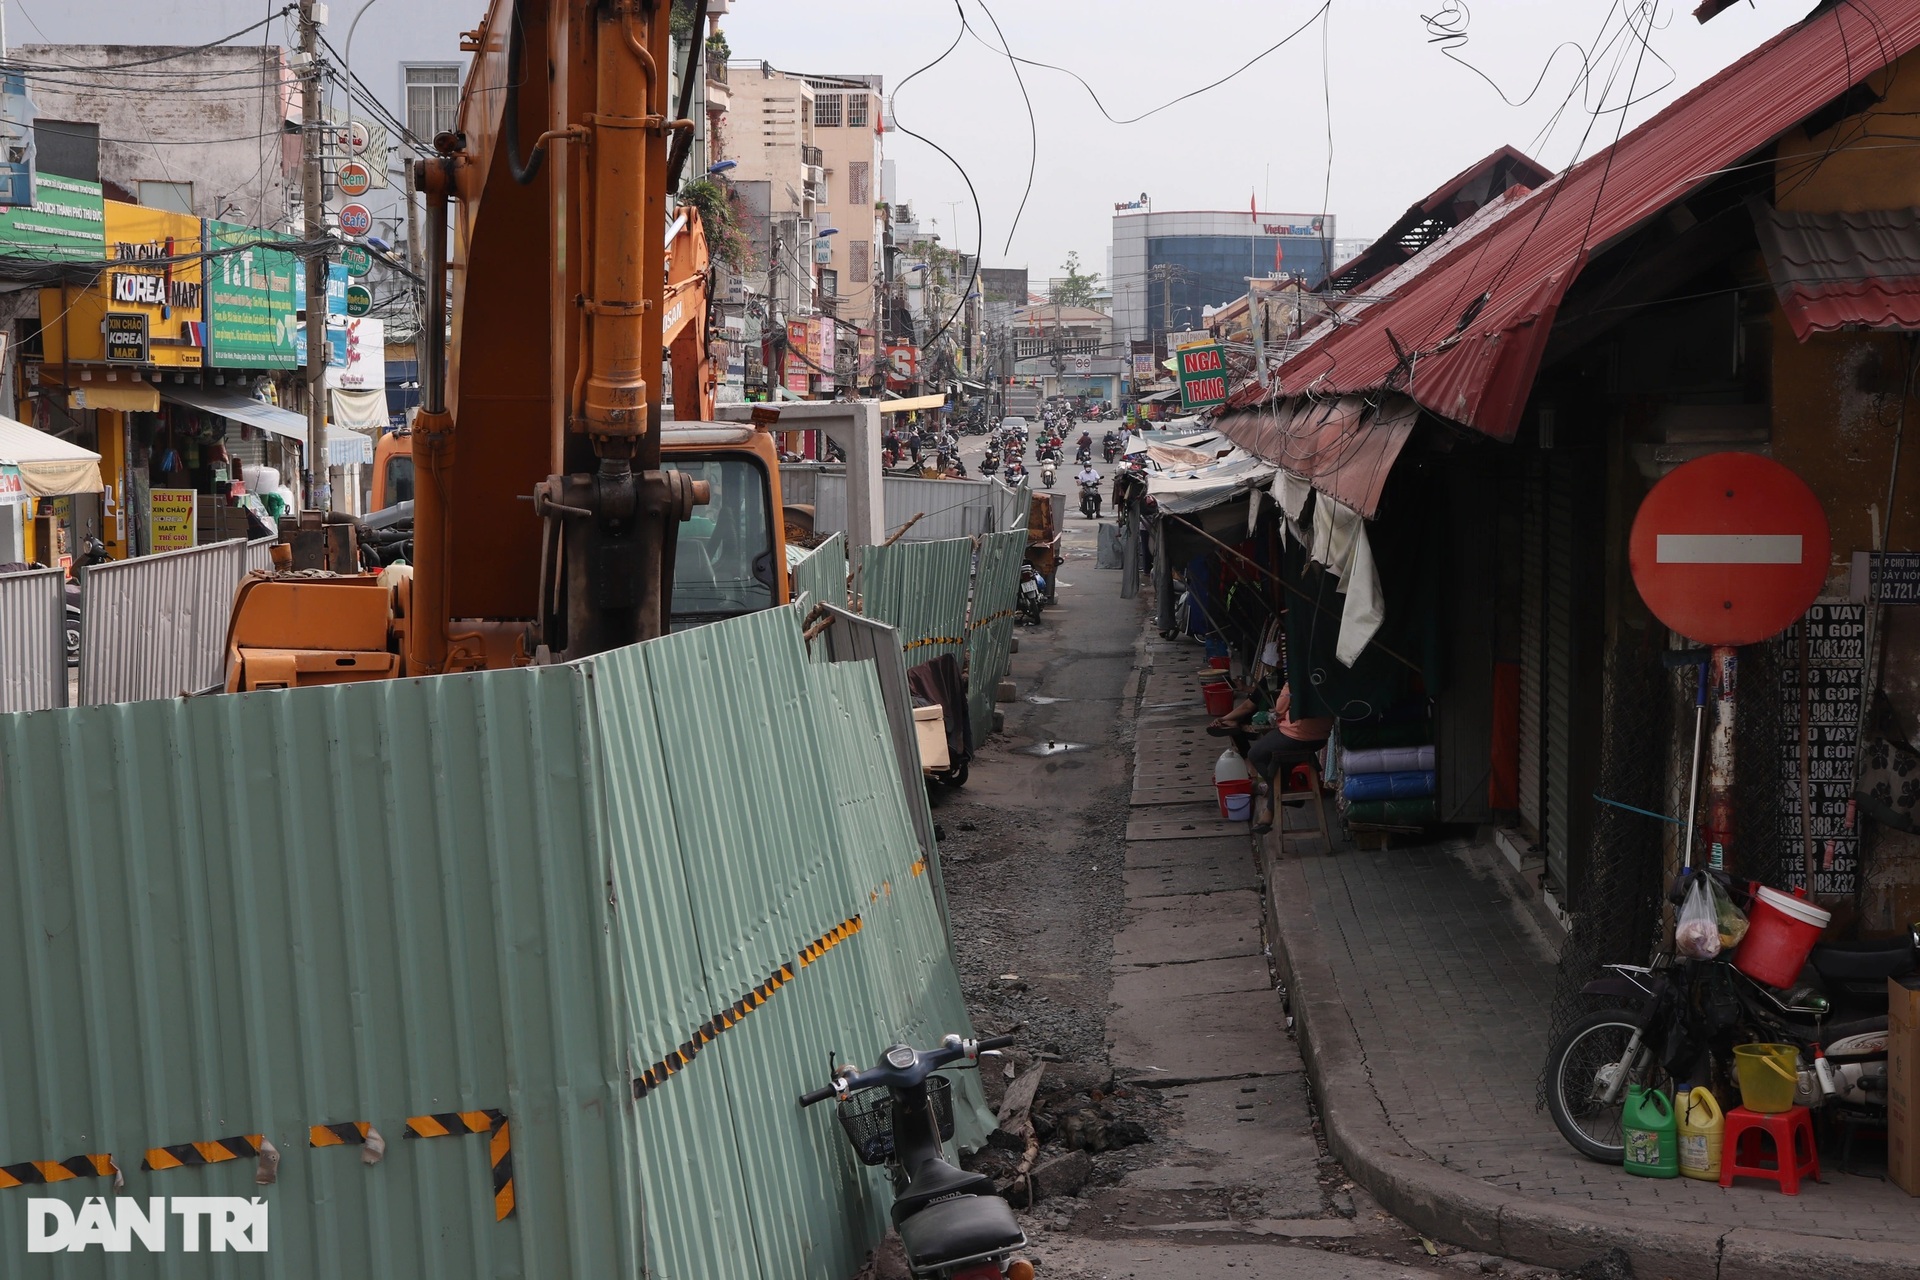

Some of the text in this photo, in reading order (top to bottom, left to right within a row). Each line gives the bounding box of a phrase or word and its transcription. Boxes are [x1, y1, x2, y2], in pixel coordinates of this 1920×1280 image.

[342, 171, 366, 187] Kem
[342, 212, 366, 228] Café
[115, 273, 166, 305] KOREA
[170, 281, 201, 308] MART
[109, 317, 142, 330] XIN CHÀO
[109, 333, 142, 345] KOREA
[114, 348, 138, 359] MART
[1183, 350, 1222, 373] NGA
[1186, 377, 1226, 403] TRANG
[153, 493, 192, 503] SIÊU THỊ
[1891, 557, 1905, 569] CHỢ
[1830, 606, 1863, 620] VAY
[1829, 622, 1864, 638] GÓP
